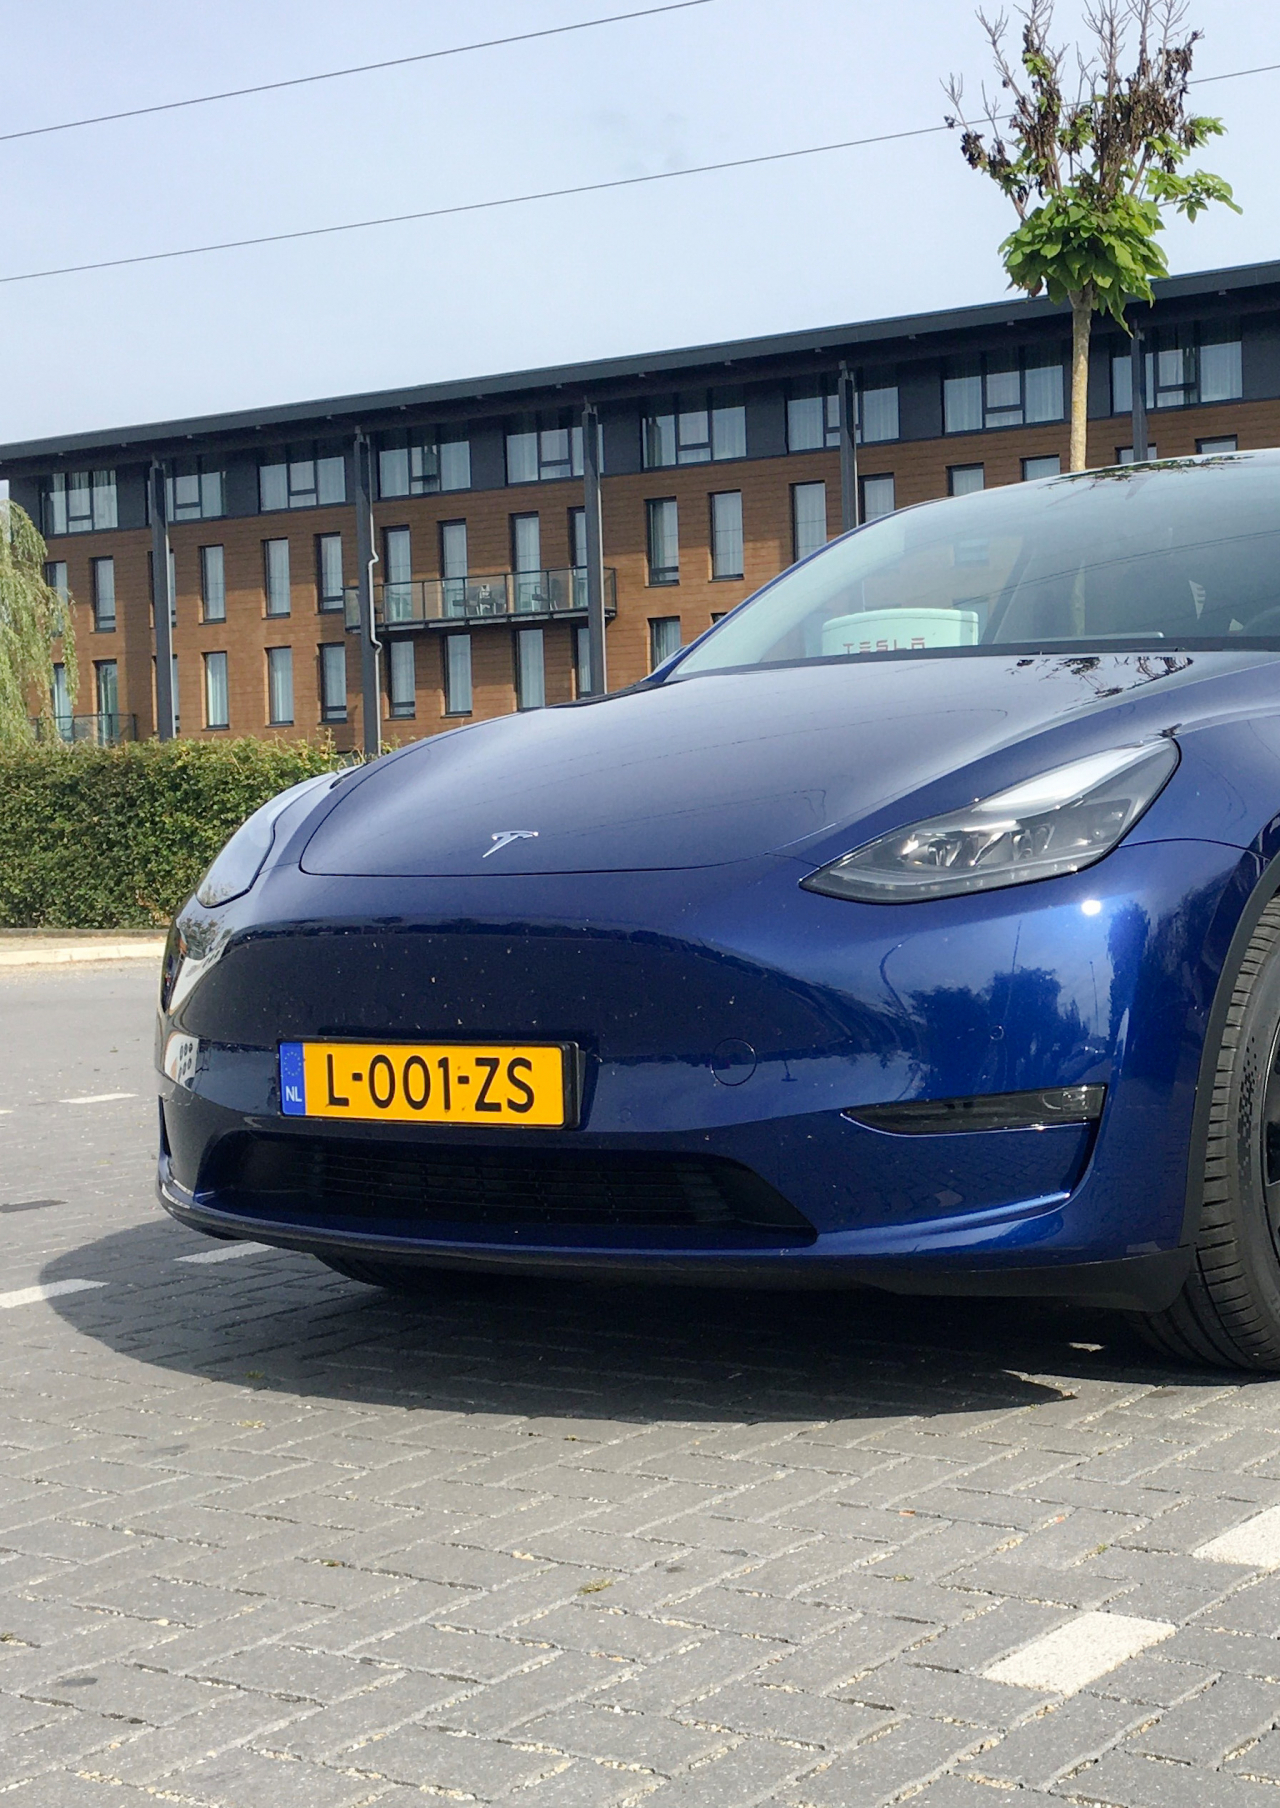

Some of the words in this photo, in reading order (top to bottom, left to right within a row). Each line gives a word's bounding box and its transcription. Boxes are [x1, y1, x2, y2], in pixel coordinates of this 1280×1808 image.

[842, 637, 926, 654] TESLA
[325, 1053, 536, 1114] L-001-ZS
[285, 1085, 303, 1103] NL
